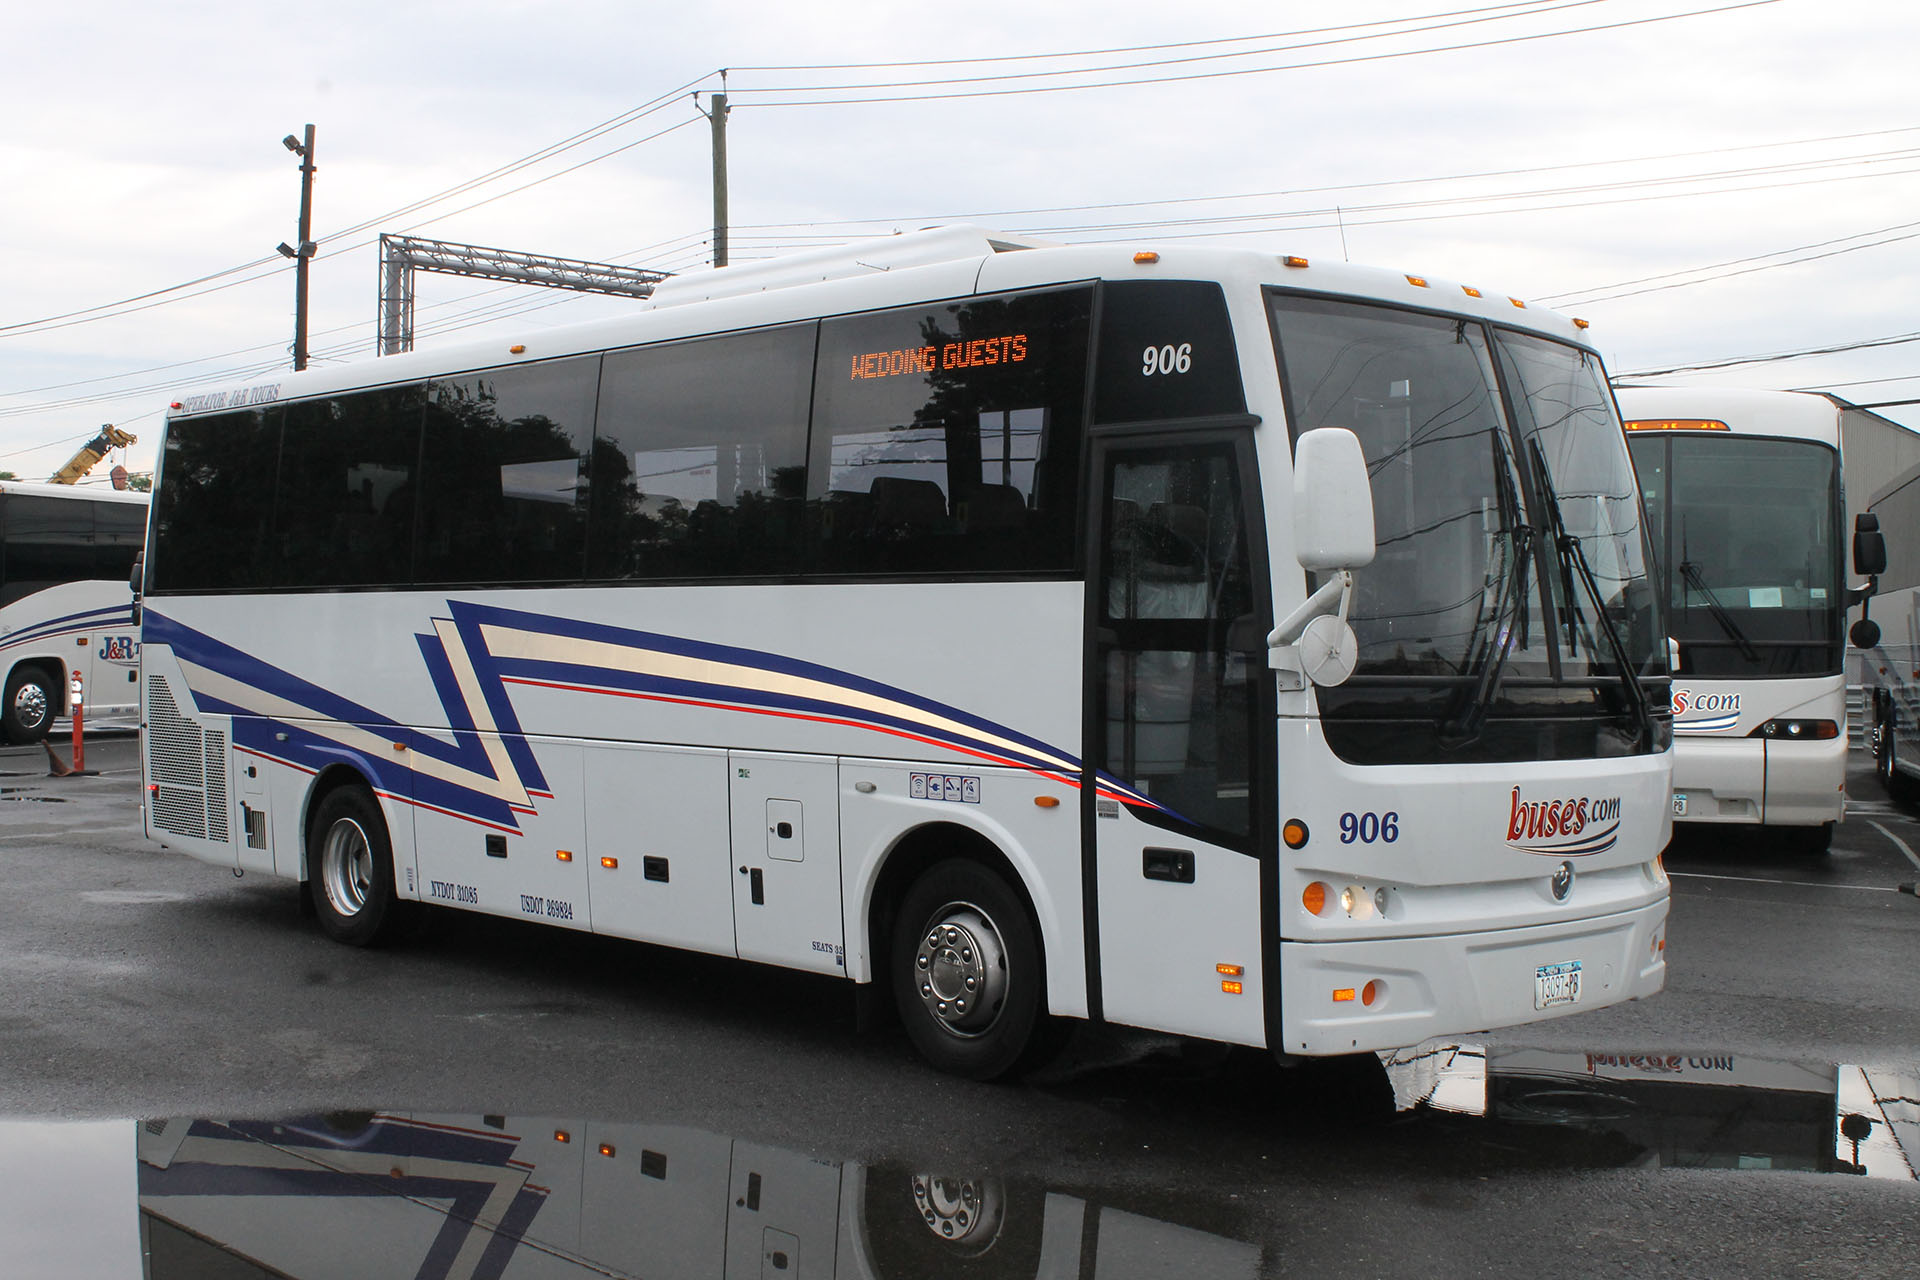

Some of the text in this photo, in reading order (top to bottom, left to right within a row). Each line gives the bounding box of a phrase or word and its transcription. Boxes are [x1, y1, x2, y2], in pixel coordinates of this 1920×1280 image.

[851, 334, 1027, 380] WEDDING GUESTS
[1142, 343, 1192, 376] 906
[249, 383, 281, 403] TOURS
[99, 636, 134, 660] J&R
[1506, 784, 1621, 841] buses.com
[1339, 811, 1399, 844] 906
[431, 880, 479, 904] NYDOT 31085
[520, 894, 574, 920] USDOT 269824
[811, 940, 843, 955] SEATS 32
